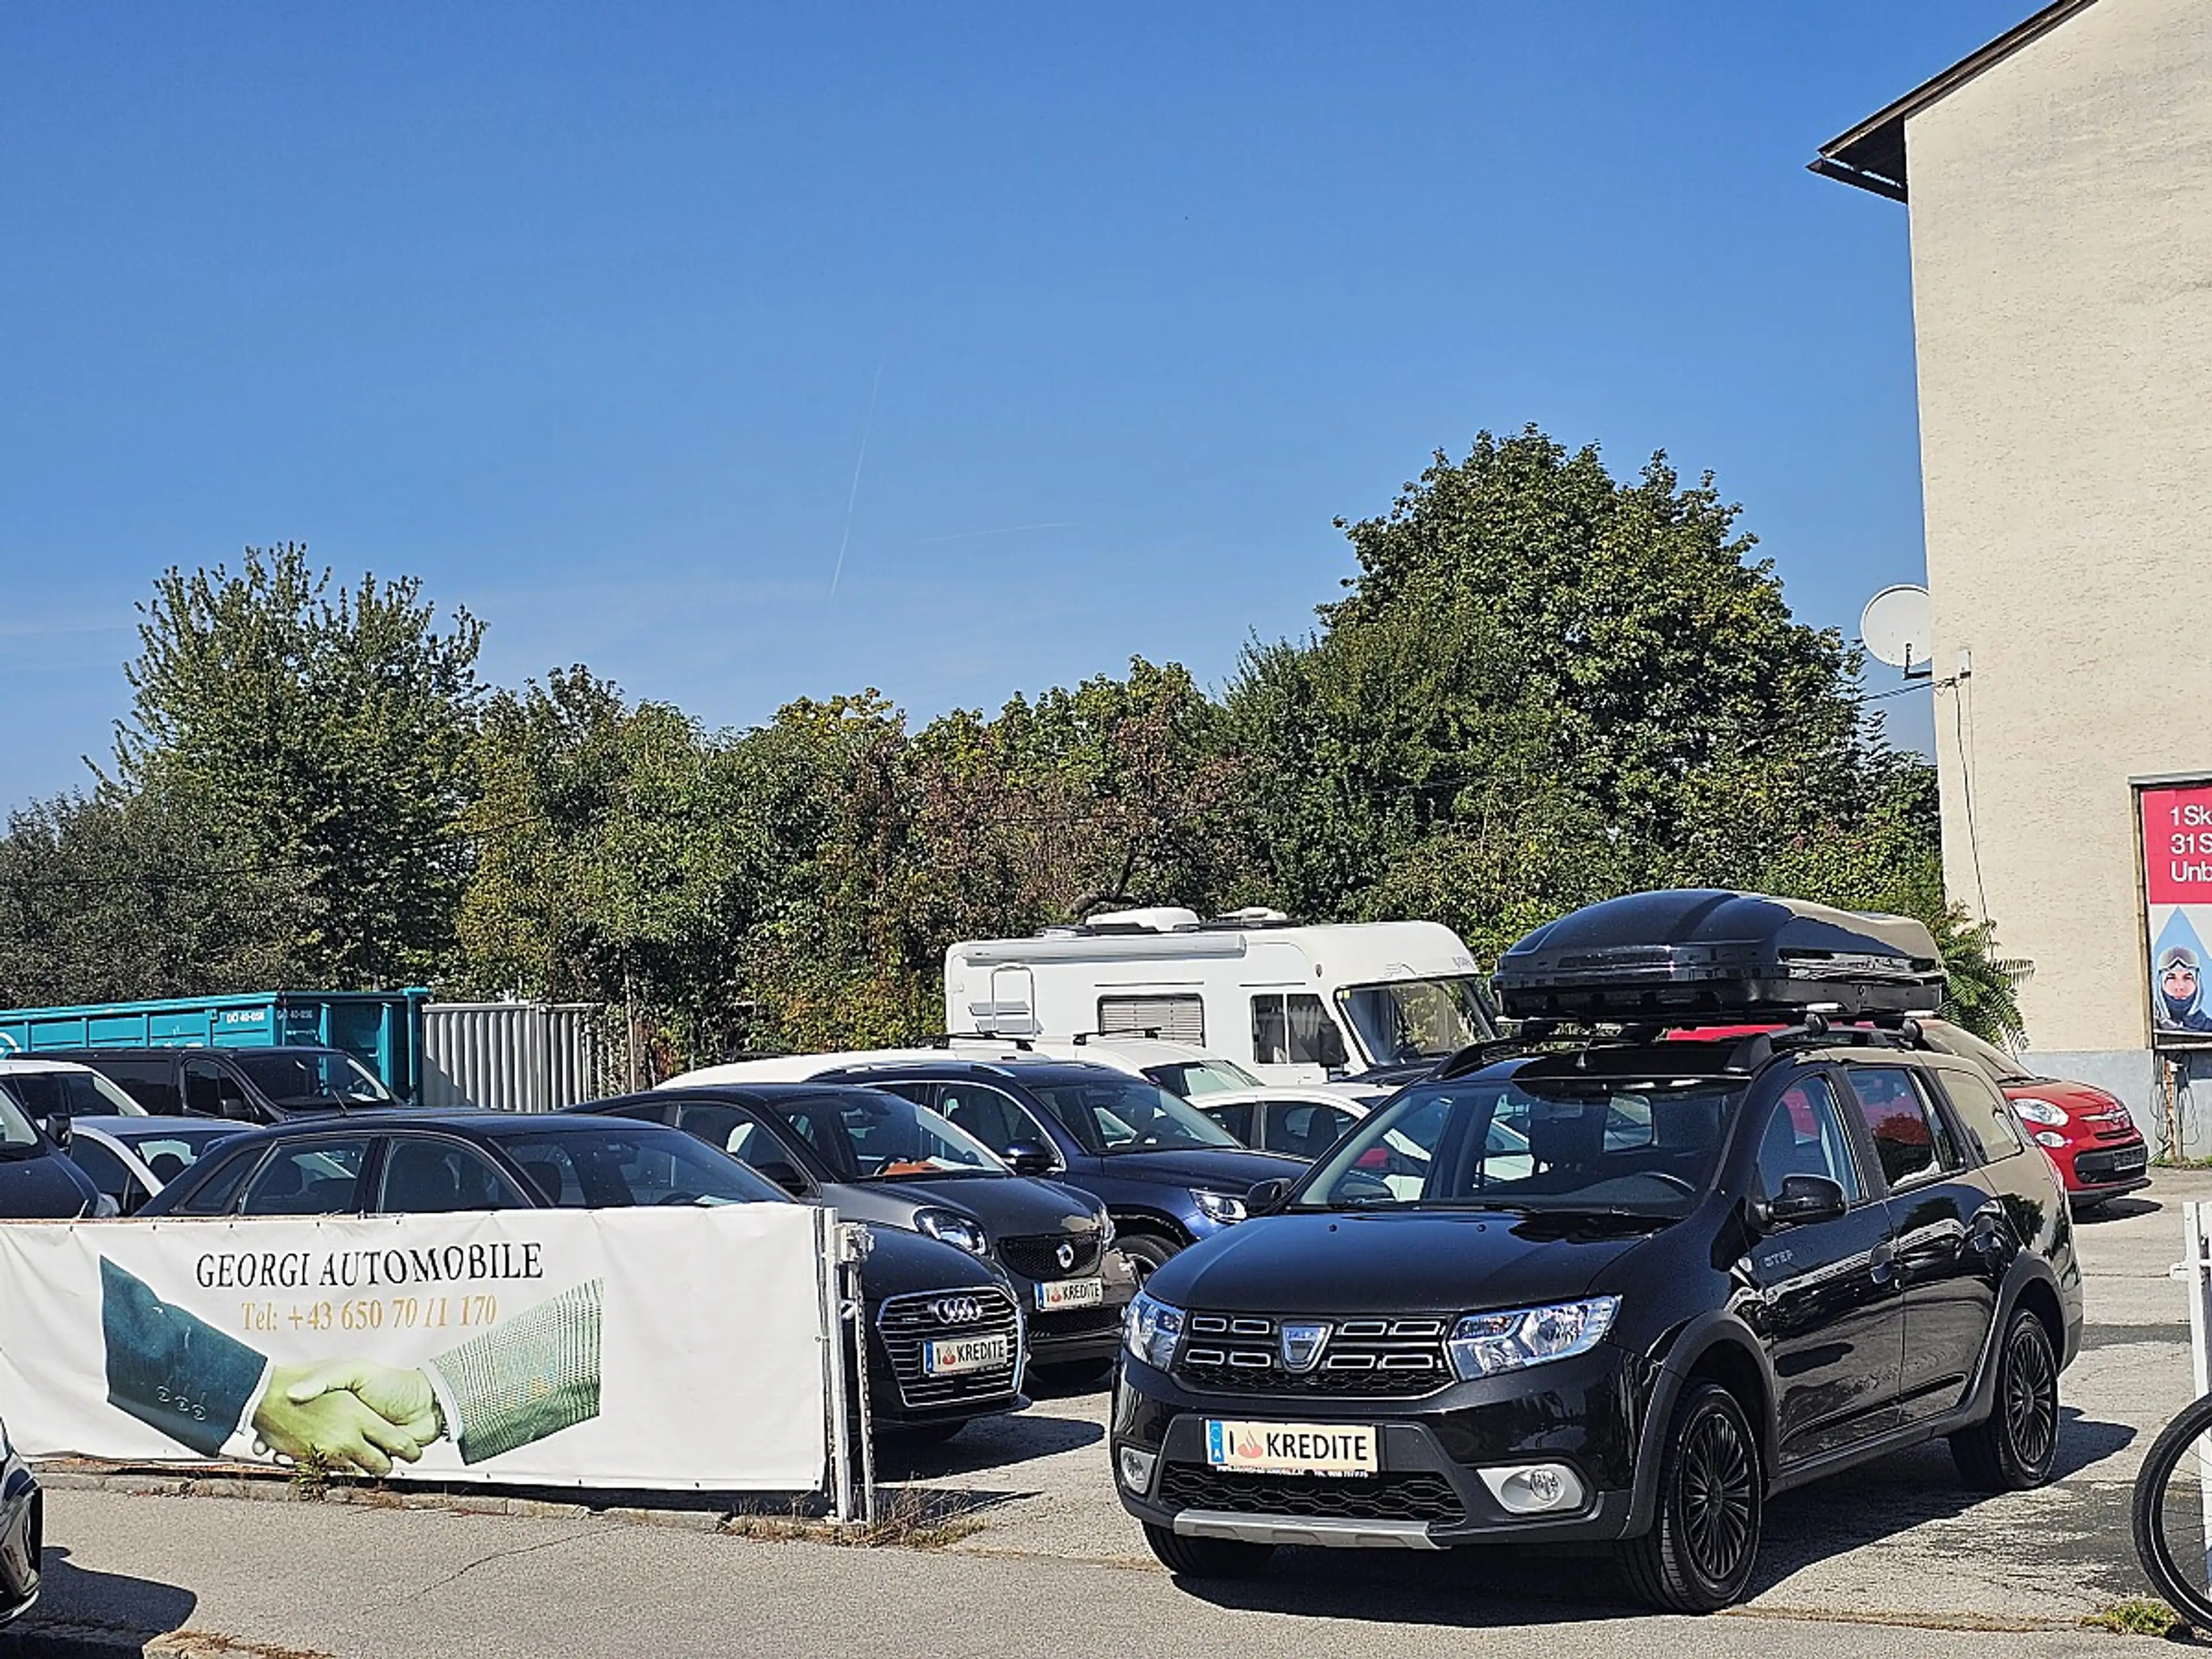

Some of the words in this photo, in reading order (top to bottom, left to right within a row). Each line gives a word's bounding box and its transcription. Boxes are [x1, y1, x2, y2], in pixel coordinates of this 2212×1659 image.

[2169, 806, 2180, 827] 1
[2170, 833, 2195, 855] 31
[196, 1253, 310, 1287] GEORGI
[319, 1243, 543, 1287] AUTOMOBILE
[1062, 1282, 1100, 1301] KREDITE
[241, 1302, 277, 1330] Tel:
[288, 1301, 332, 1330] +43
[341, 1300, 382, 1330] 650
[392, 1297, 418, 1328] 70
[459, 1295, 497, 1325] 170
[956, 1340, 1003, 1363] KREDITE
[1229, 1430, 1234, 1456] I
[1266, 1432, 1368, 1461] KREDITE
